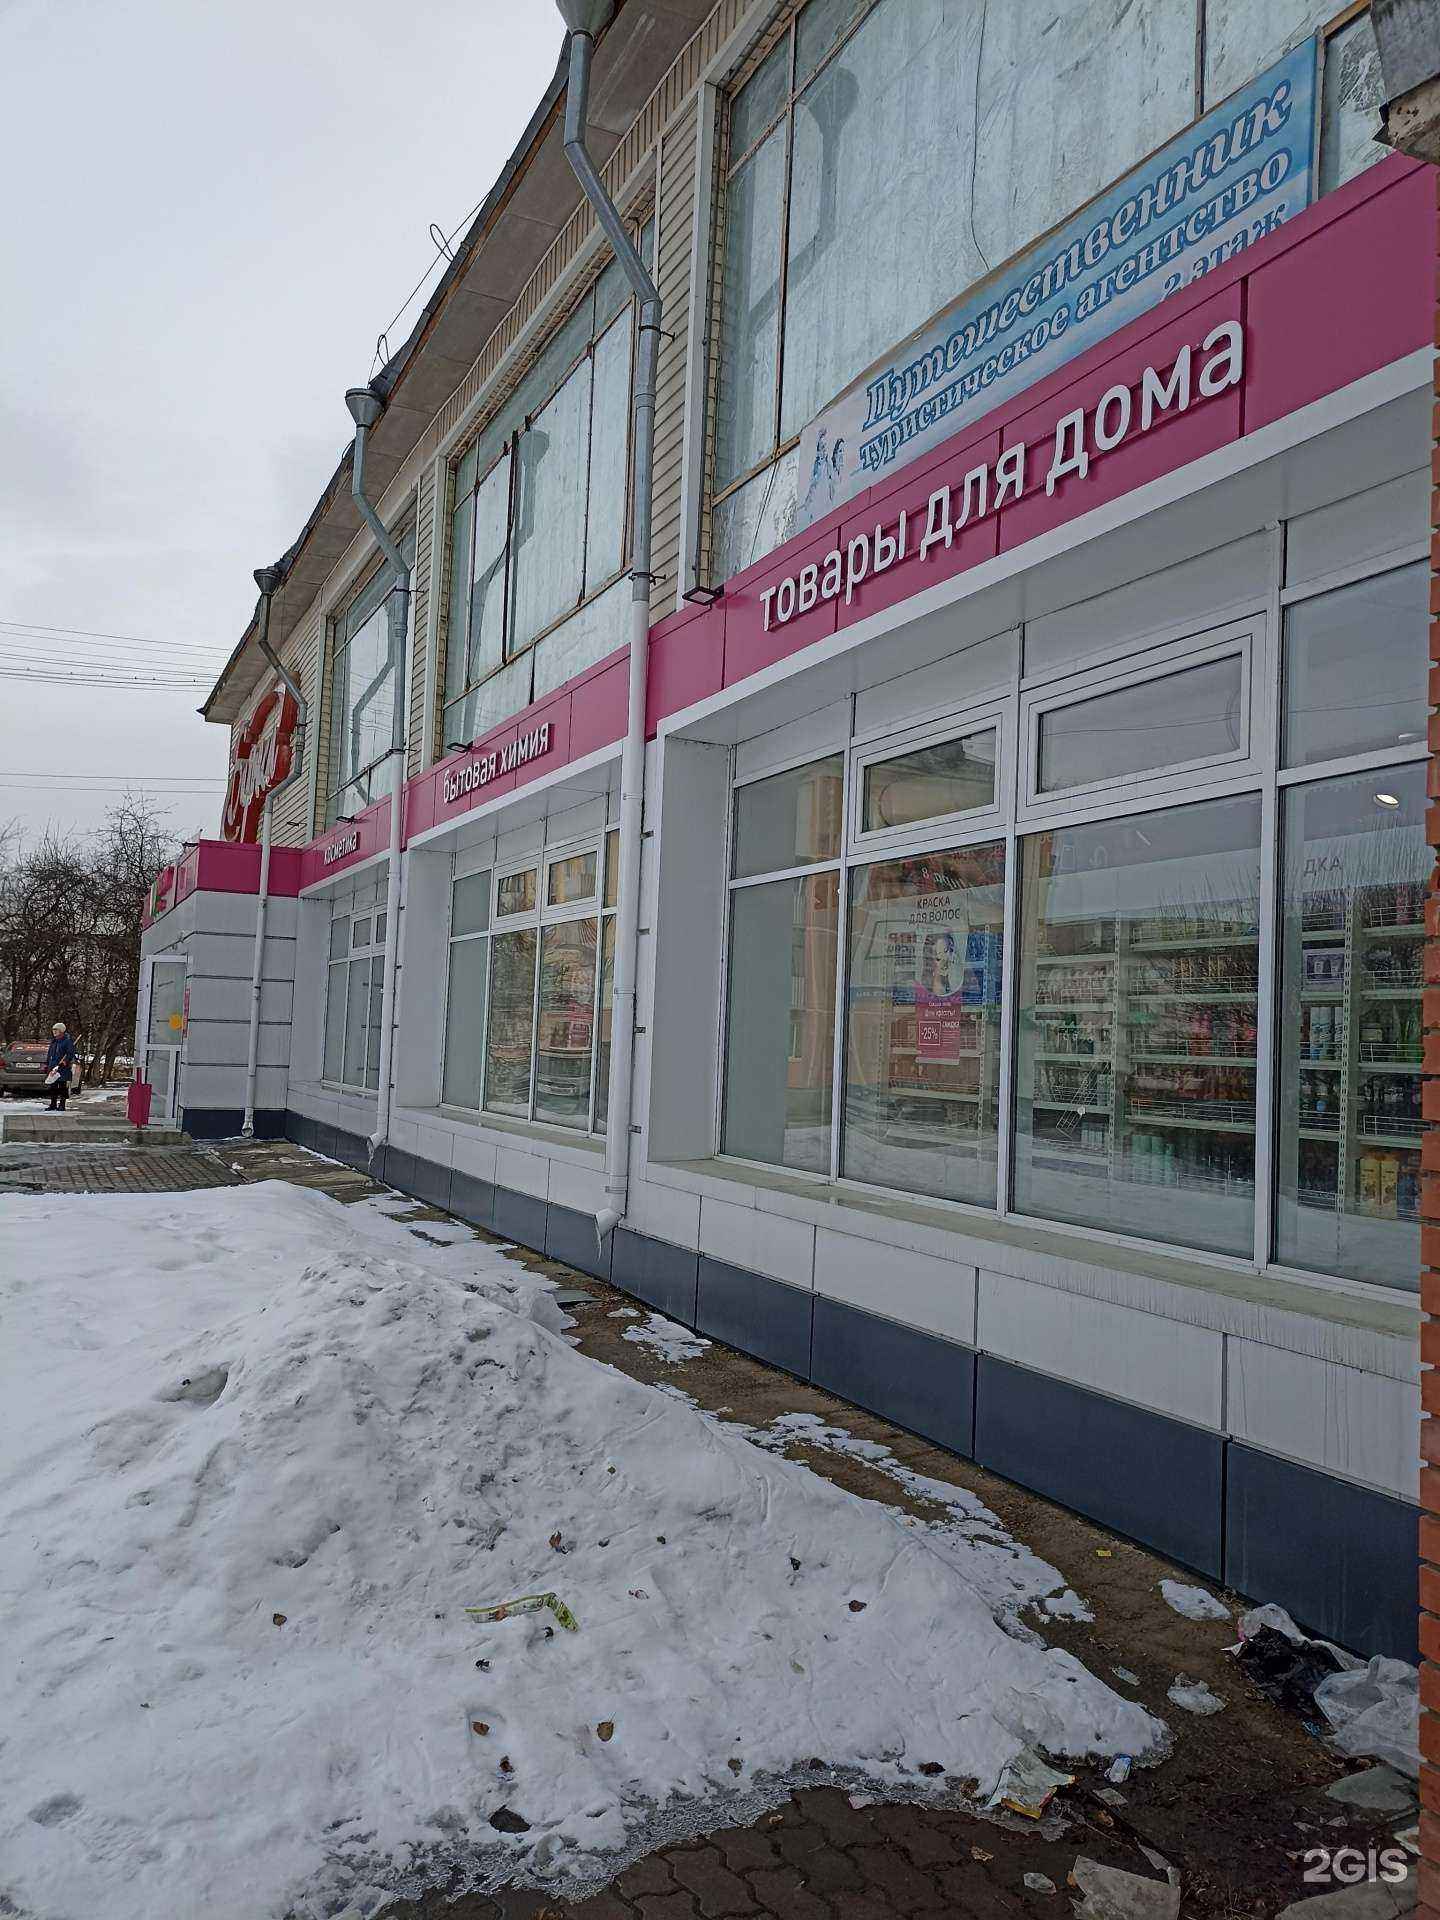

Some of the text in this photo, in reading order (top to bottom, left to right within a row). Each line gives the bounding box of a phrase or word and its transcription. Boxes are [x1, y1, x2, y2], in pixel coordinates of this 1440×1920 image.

[862, 78, 1293, 433] Путешественник
[1074, 147, 1293, 323] агентство
[760, 319, 1244, 632] товары для дома
[443, 722, 549, 804] бытовая химия
[917, 895, 951, 909] КРАСКА
[929, 908, 961, 922] ВОЛОС
